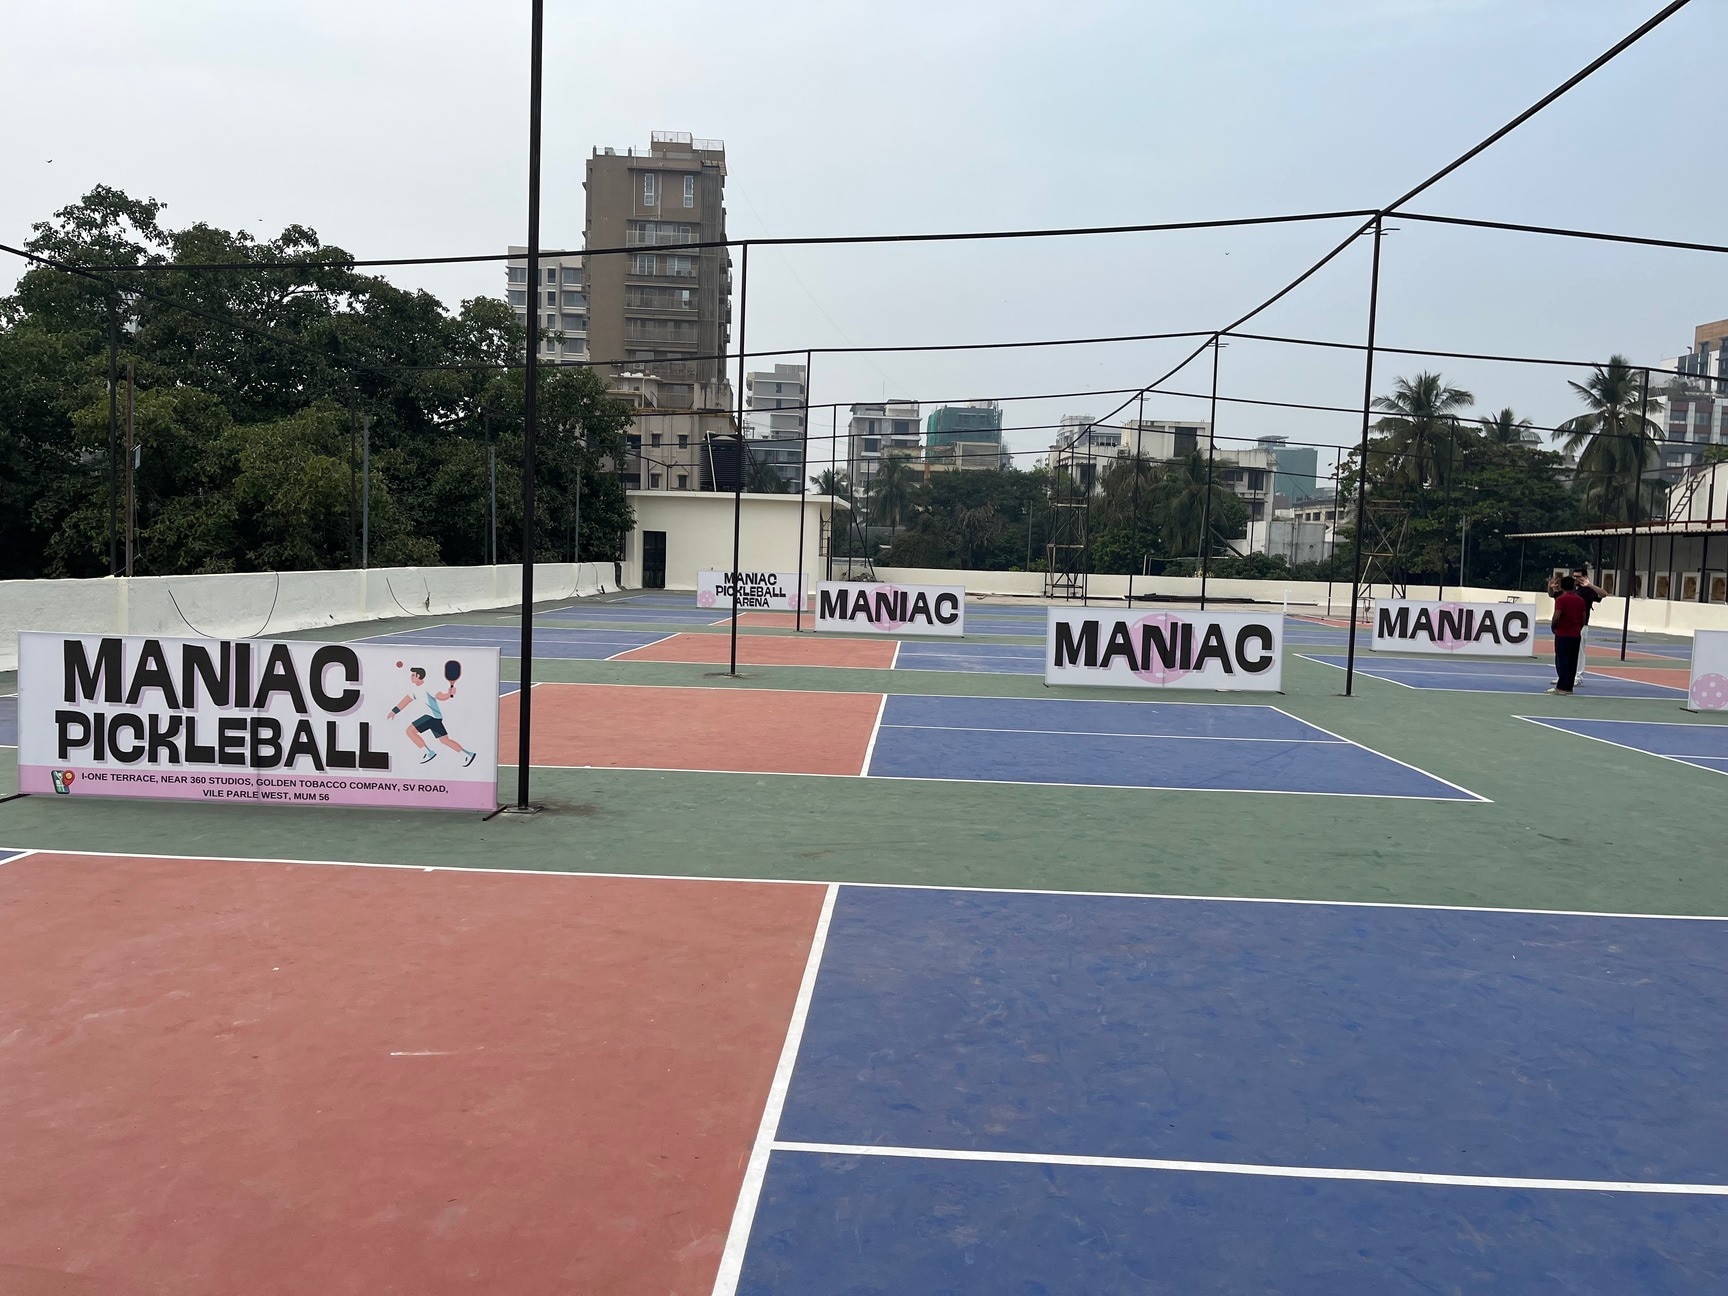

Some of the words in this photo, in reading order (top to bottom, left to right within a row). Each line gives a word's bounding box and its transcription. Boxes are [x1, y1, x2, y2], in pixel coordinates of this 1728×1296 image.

[715, 585, 786, 598] PICKLEBALL
[724, 572, 777, 586] MANIAC
[736, 597, 770, 608] ARENA
[819, 588, 959, 625] MANIAC
[1377, 606, 1530, 645] MANIAC
[1054, 620, 1274, 674] MANIAC
[63, 637, 362, 714] MANIAC
[54, 709, 391, 771] PICKLEBALL
[81, 772, 108, 781] I-ONE
[110, 773, 158, 784] TERRACE,
[160, 775, 188, 784] NEAR
[190, 776, 206, 784] 360
[208, 776, 254, 787] STUDIOS,
[256, 778, 297, 788] GOLDEN
[299, 779, 347, 789] TOBACCO
[349, 781, 400, 792] COMPANY,
[402, 783, 416, 792] SV
[418, 784, 449, 794] ROAD,
[202, 789, 224, 798] VILE
[226, 790, 258, 798] PARLE
[260, 791, 292, 801] WEST,
[293, 792, 317, 800] MUM
[318, 793, 330, 801] 56
